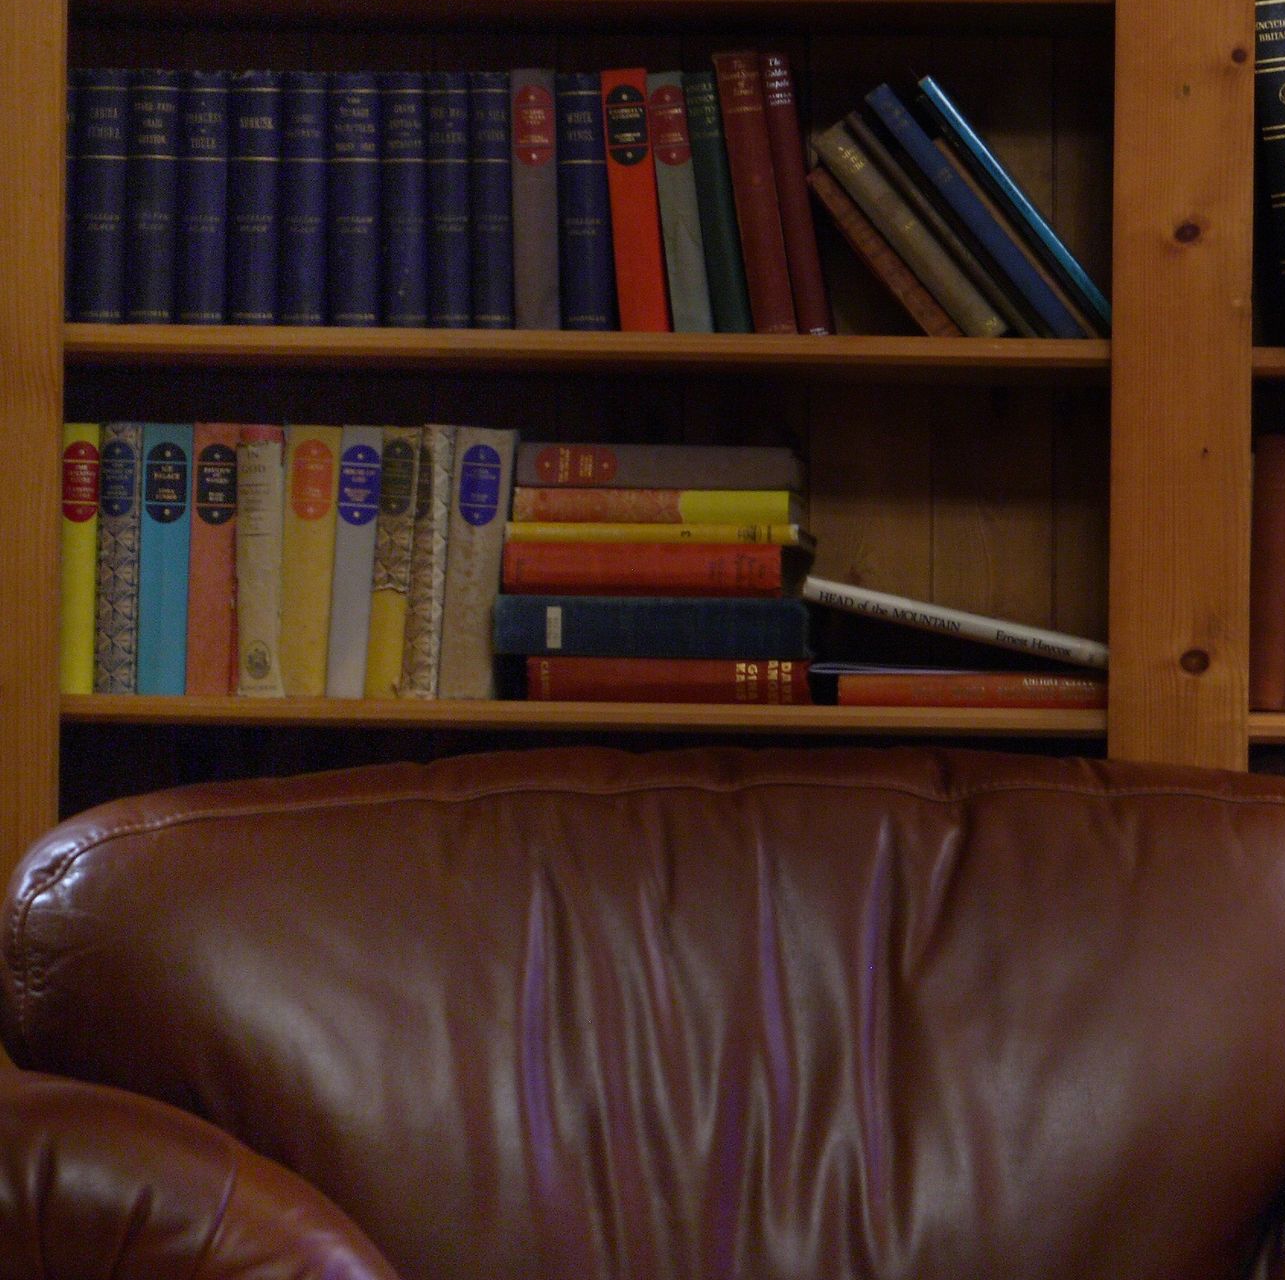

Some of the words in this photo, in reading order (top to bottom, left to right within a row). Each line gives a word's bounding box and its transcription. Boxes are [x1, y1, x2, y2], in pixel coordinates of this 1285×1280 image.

[818, 591, 854, 608] HEAD
[858, 598, 869, 610] of
[870, 601, 889, 616] the
[892, 608, 962, 632] MOUNTAIN
[996, 630, 1028, 648] Ernest
